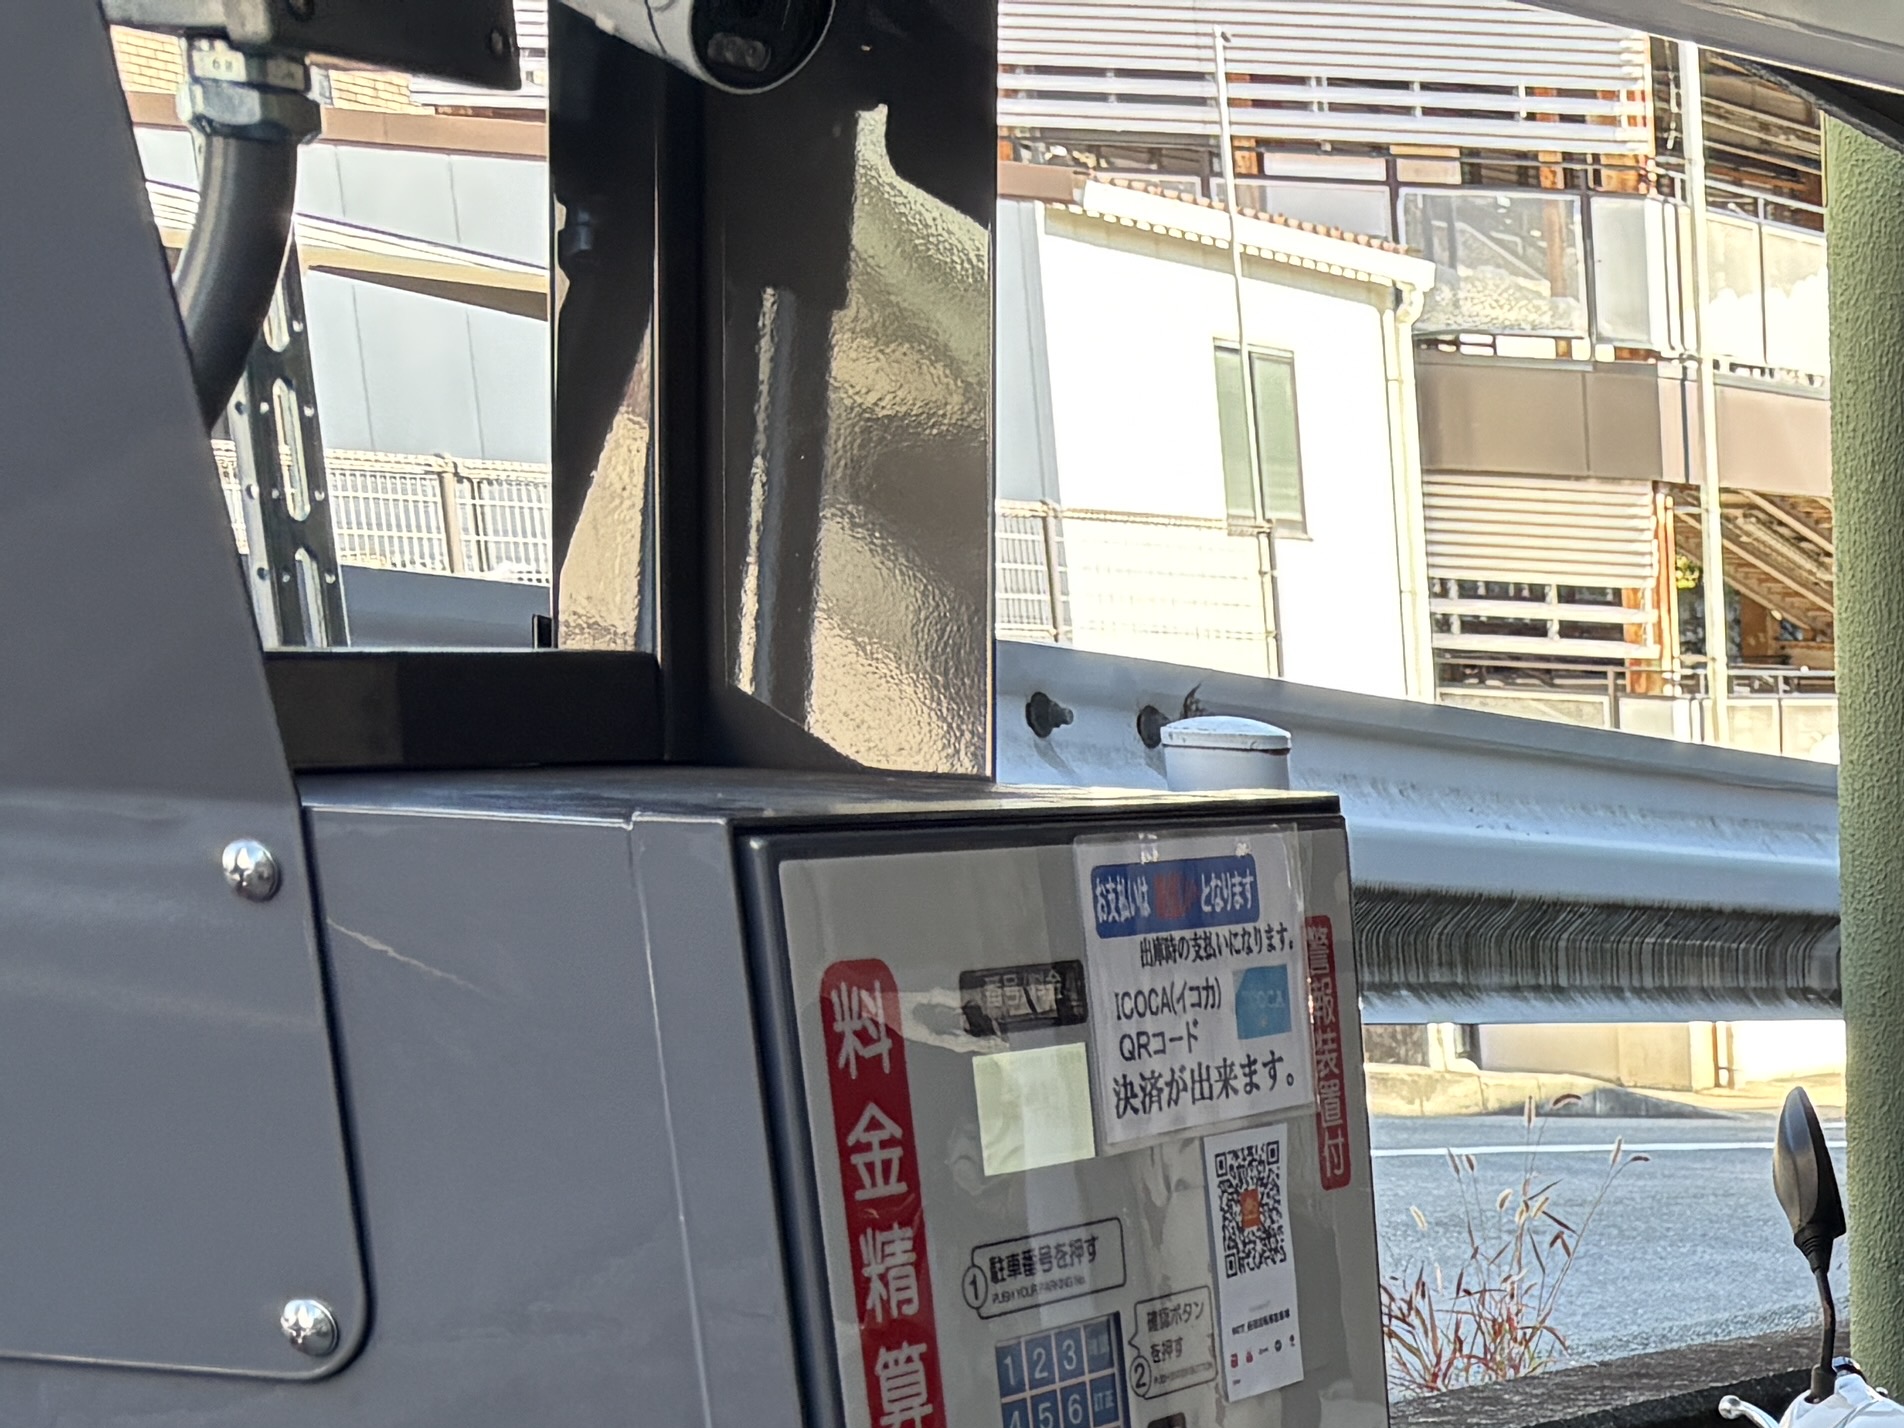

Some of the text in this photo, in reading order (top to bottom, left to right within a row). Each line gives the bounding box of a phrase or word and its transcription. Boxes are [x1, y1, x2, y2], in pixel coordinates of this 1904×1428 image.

[1140, 922, 1294, 968] 出庫時の支払いになります。
[1114, 976, 1222, 1021] ICOCA(イコカ)
[1119, 1019, 1199, 1062] QRコード
[1307, 926, 1345, 1177] 警報装置付
[1113, 1050, 1295, 1120] 決済が出来ます。
[989, 1234, 1099, 1284] 駐車番号を押す
[1004, 1355, 1017, 1387] 1
[1033, 1347, 1049, 1379] 2
[1062, 1339, 1077, 1371] 3
[1067, 1393, 1083, 1424] 6
